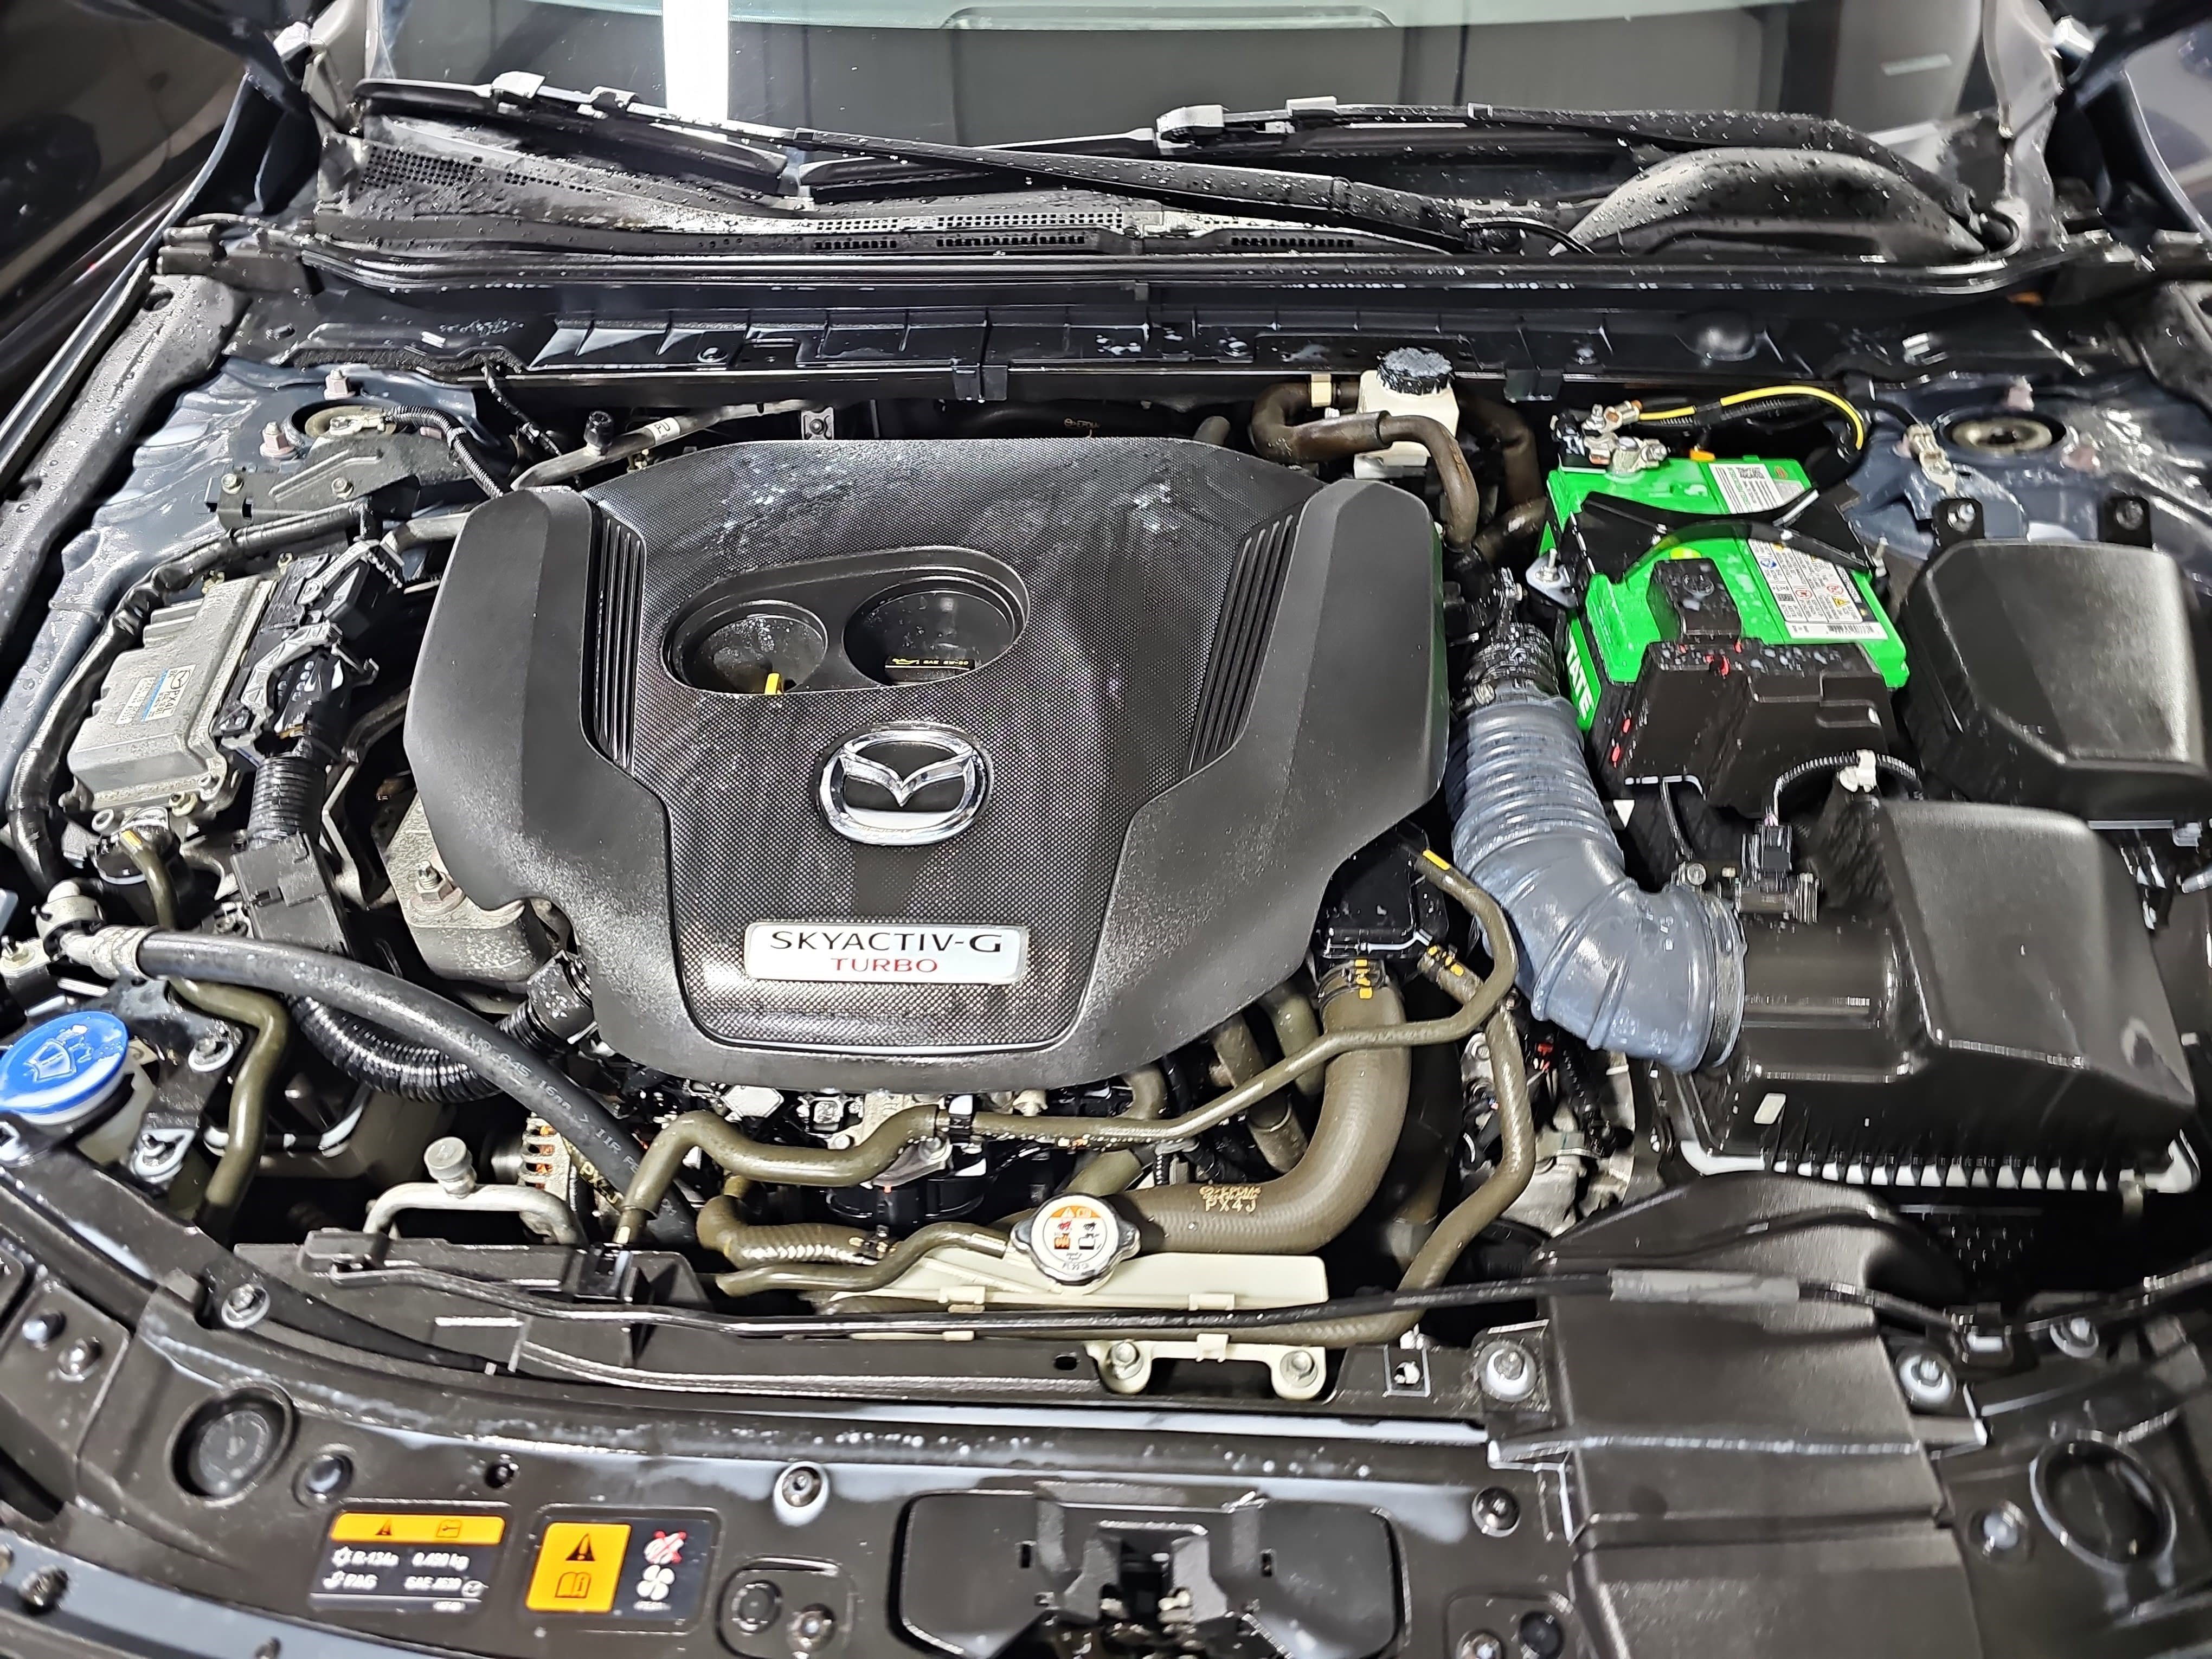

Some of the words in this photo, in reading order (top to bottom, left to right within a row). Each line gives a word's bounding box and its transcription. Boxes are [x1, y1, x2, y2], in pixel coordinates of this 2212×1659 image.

[653, 421, 671, 434] PU
[1566, 629, 1594, 721] TATE
[770, 931, 1002, 953] SKYACTIV-G
[830, 957, 938, 973] TURBO
[538, 1079, 573, 1110] 16mm
[1205, 1197, 1256, 1212] PX4J
[343, 1573, 378, 1590] PAG
